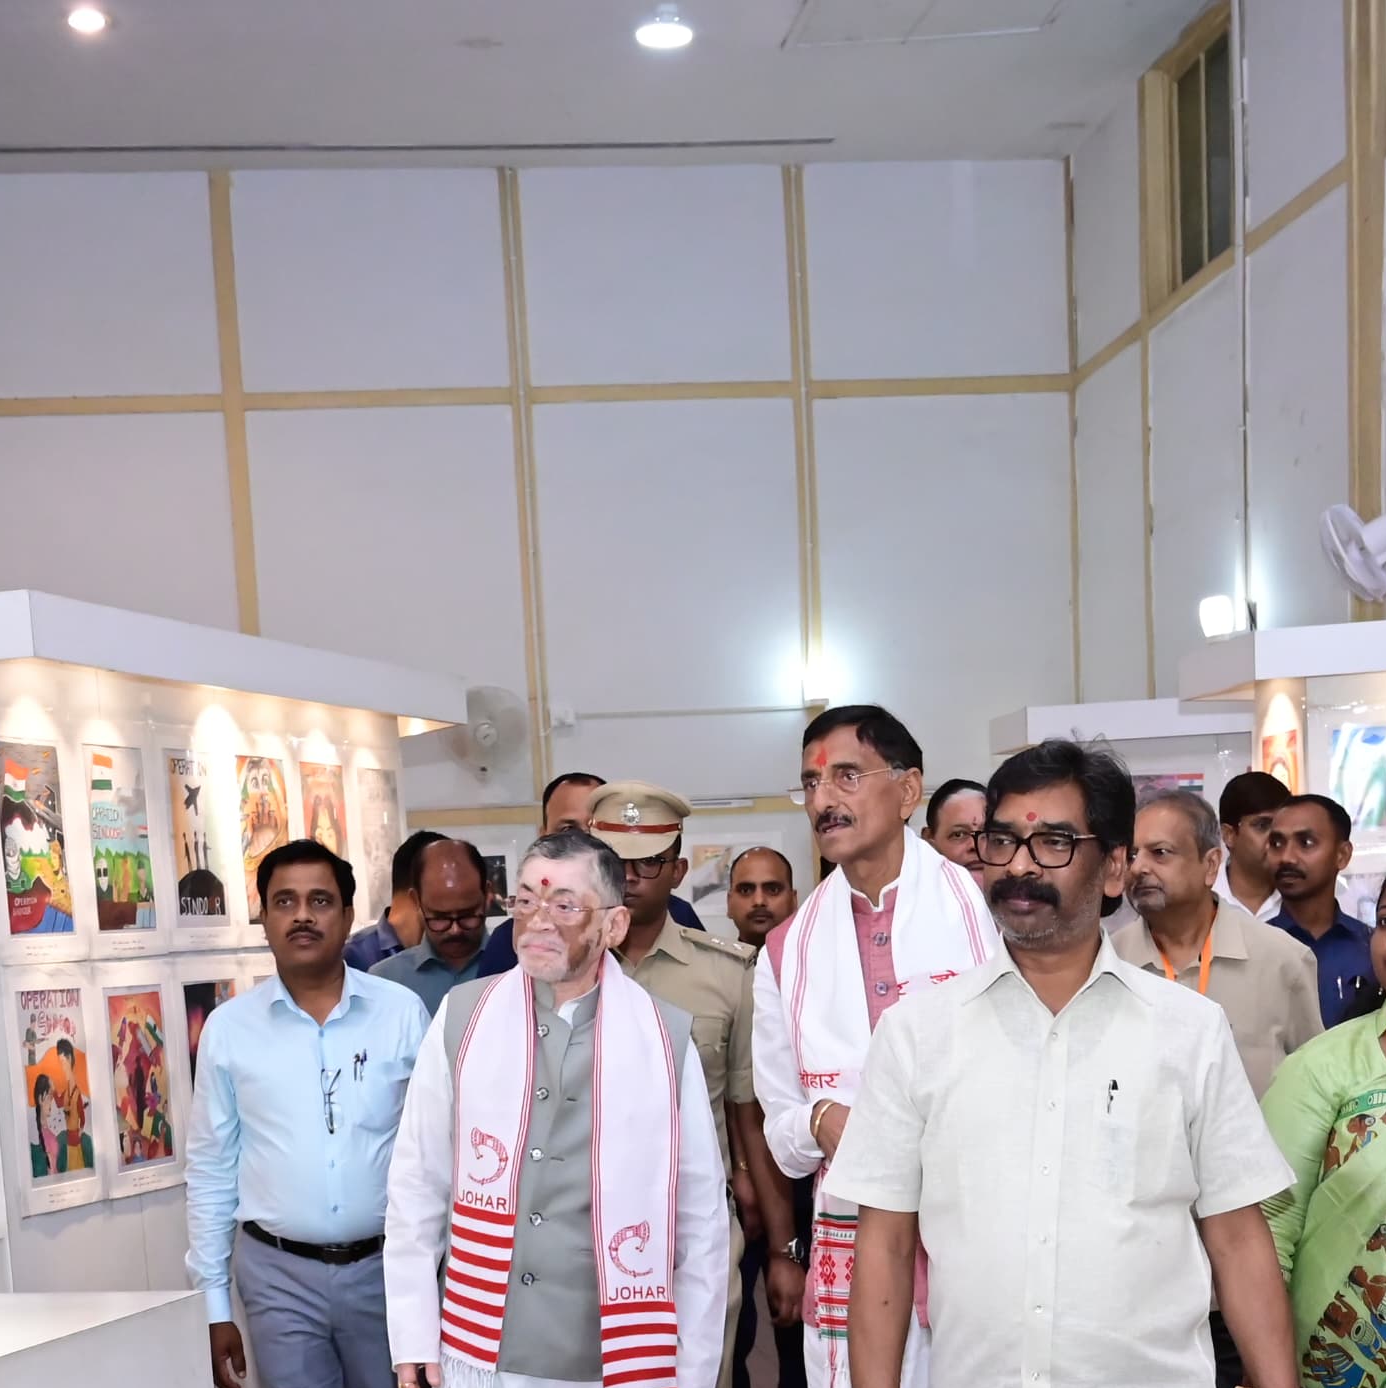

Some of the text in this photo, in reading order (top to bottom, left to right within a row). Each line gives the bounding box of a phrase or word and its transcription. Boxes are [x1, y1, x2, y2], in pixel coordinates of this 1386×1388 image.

[20, 988, 79, 1011] OPERATION
[459, 1189, 507, 1211] JOHAR
[609, 1285, 665, 1301] JOHAR
